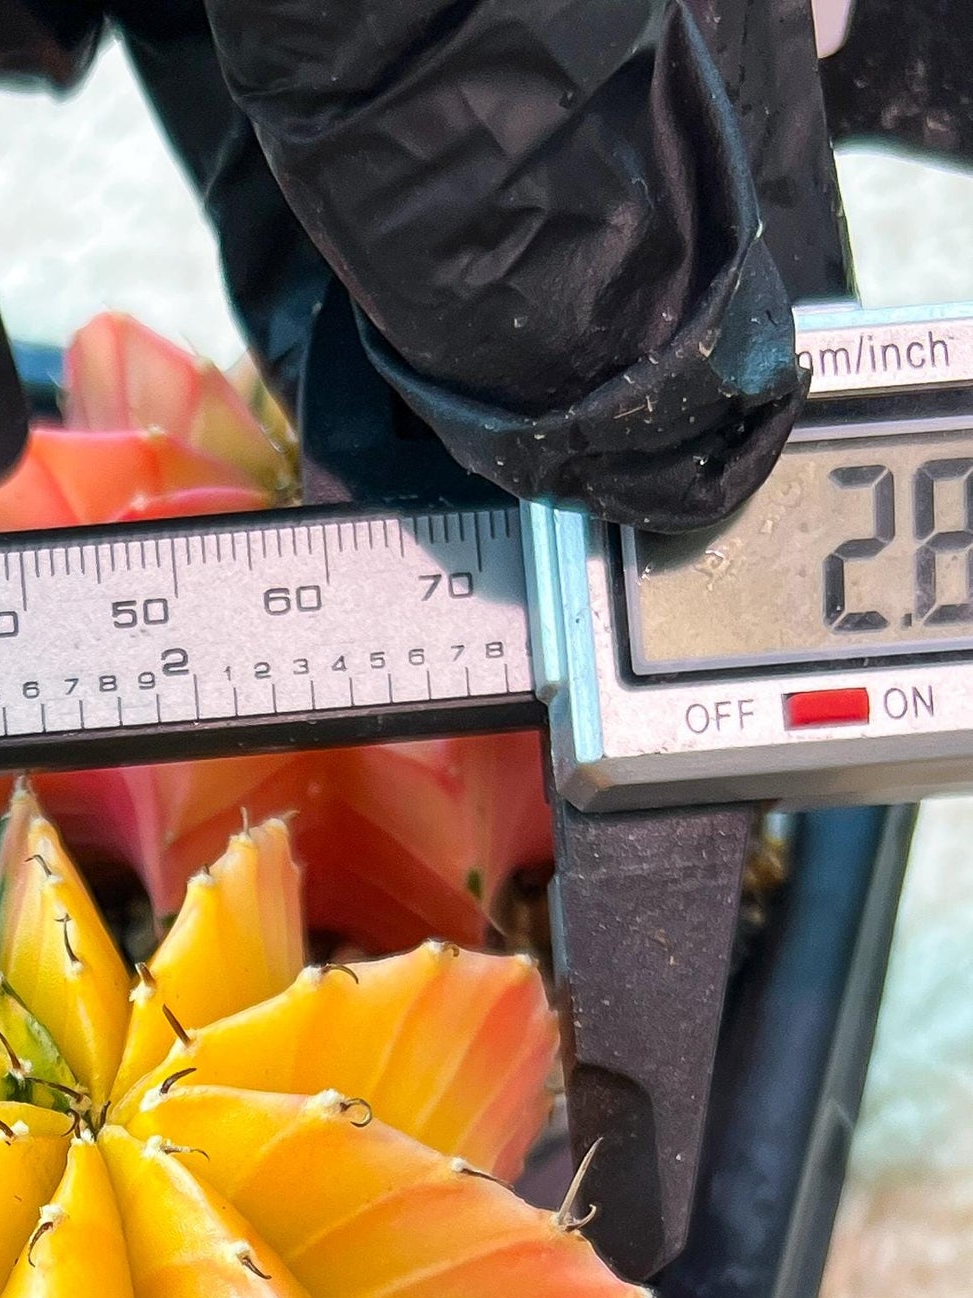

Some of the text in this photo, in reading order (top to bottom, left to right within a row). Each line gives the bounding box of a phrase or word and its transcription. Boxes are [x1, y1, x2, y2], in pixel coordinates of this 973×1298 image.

[112, 598, 169, 628] 50
[263, 585, 322, 616] 60
[418, 572, 474, 602] 70
[22, 681, 41, 700] 6
[63, 678, 80, 696] 7
[98, 675, 118, 693] 8
[137, 672, 156, 690] 9
[160, 647, 190, 677] 2
[223, 665, 232, 682] 1
[253, 662, 272, 680] 2
[292, 658, 310, 675] 3
[330, 656, 348, 672] 4
[369, 651, 386, 669] 5
[407, 648, 425, 667] 6
[450, 645, 466, 661] 7
[485, 641, 505, 659] 8
[685, 684, 936, 736] OFF ON
